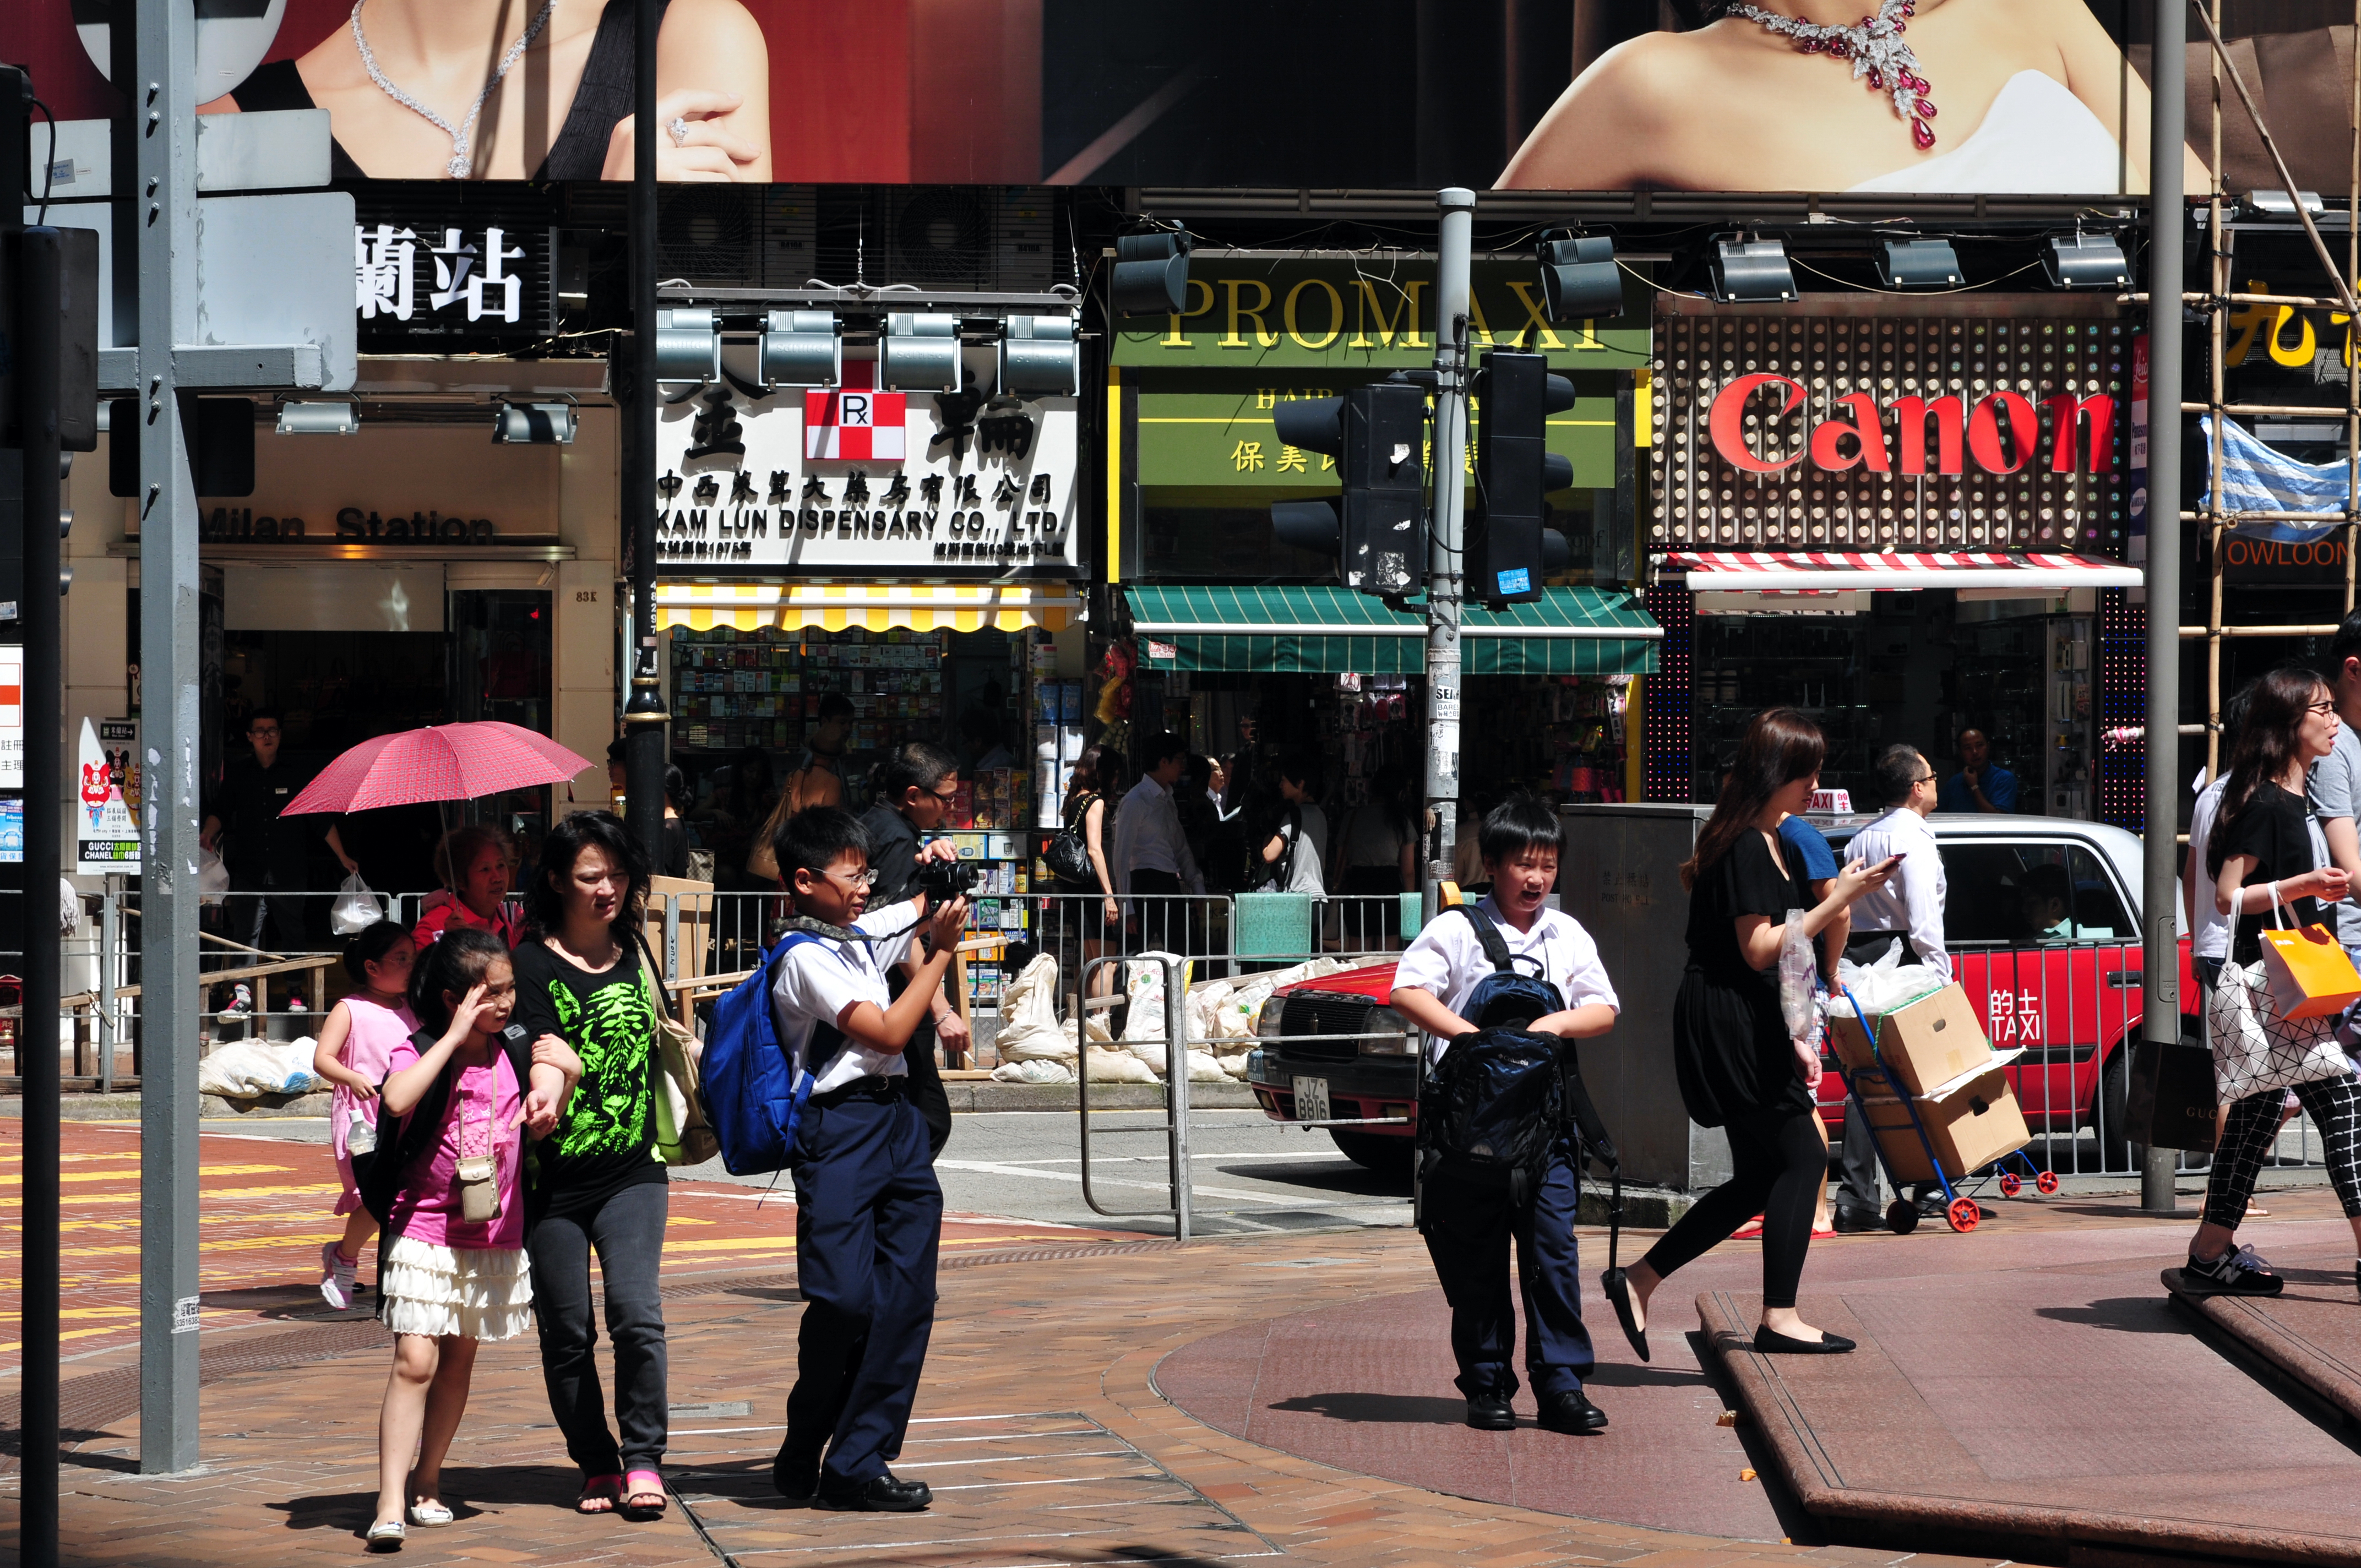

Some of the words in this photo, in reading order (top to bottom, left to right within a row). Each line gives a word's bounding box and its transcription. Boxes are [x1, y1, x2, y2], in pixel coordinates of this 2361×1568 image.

[1710, 372, 2115, 475] Canon
[198, 508, 304, 543] Milan
[336, 507, 493, 545] Station
[656, 509, 707, 530] KAM
[720, 509, 767, 530] LUN
[781, 509, 938, 532] DISPENSARY
[1013, 511, 1065, 532] LTD.
[576, 591, 597, 603] 83K
[1990, 988, 2038, 1015] 的士
[1992, 1015, 2040, 1041] TAXI
[1304, 1078, 1320, 1099] JZ
